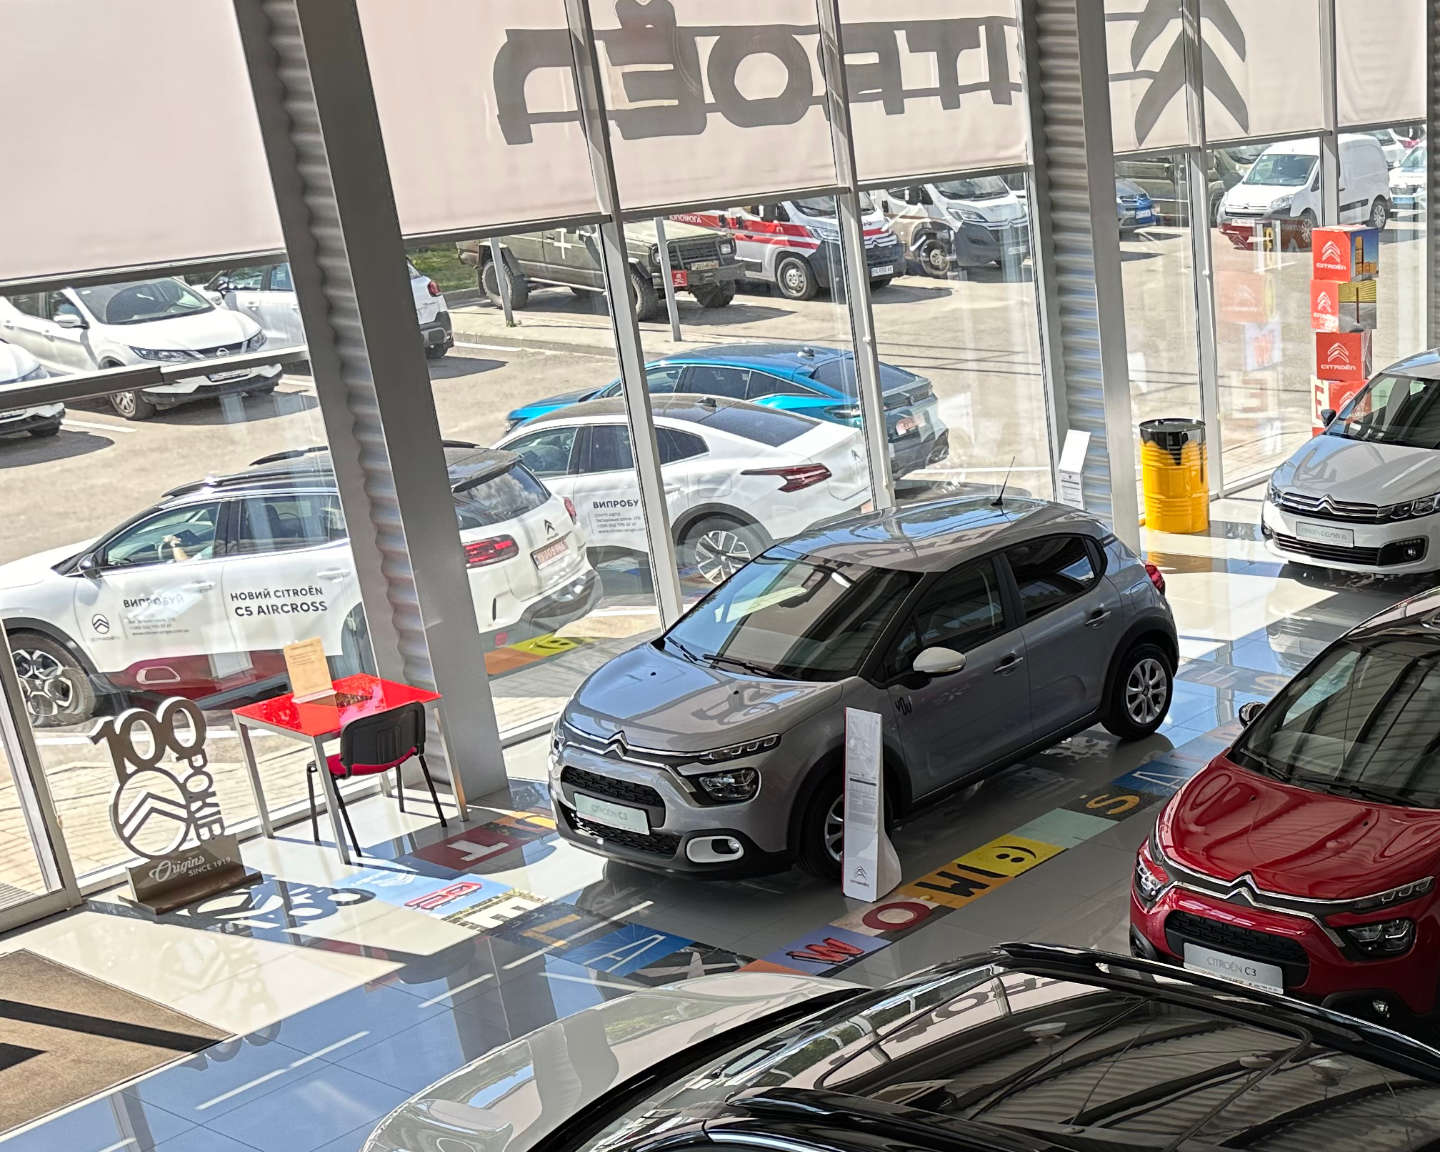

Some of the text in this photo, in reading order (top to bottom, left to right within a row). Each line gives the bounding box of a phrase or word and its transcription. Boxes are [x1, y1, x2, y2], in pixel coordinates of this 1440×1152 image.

[1316, 262, 1347, 271] CITROËN
[1321, 362, 1356, 371] CITROËN
[592, 499, 639, 509] ВИПРОБУ
[230, 585, 323, 601] НОВИЙ CITROËN
[234, 601, 328, 617] C5 AIRCROSS
[88, 697, 207, 787] 100
[149, 855, 205, 882] Origins
[188, 865, 213, 877] SINCE
[1244, 965, 1257, 977] C3
